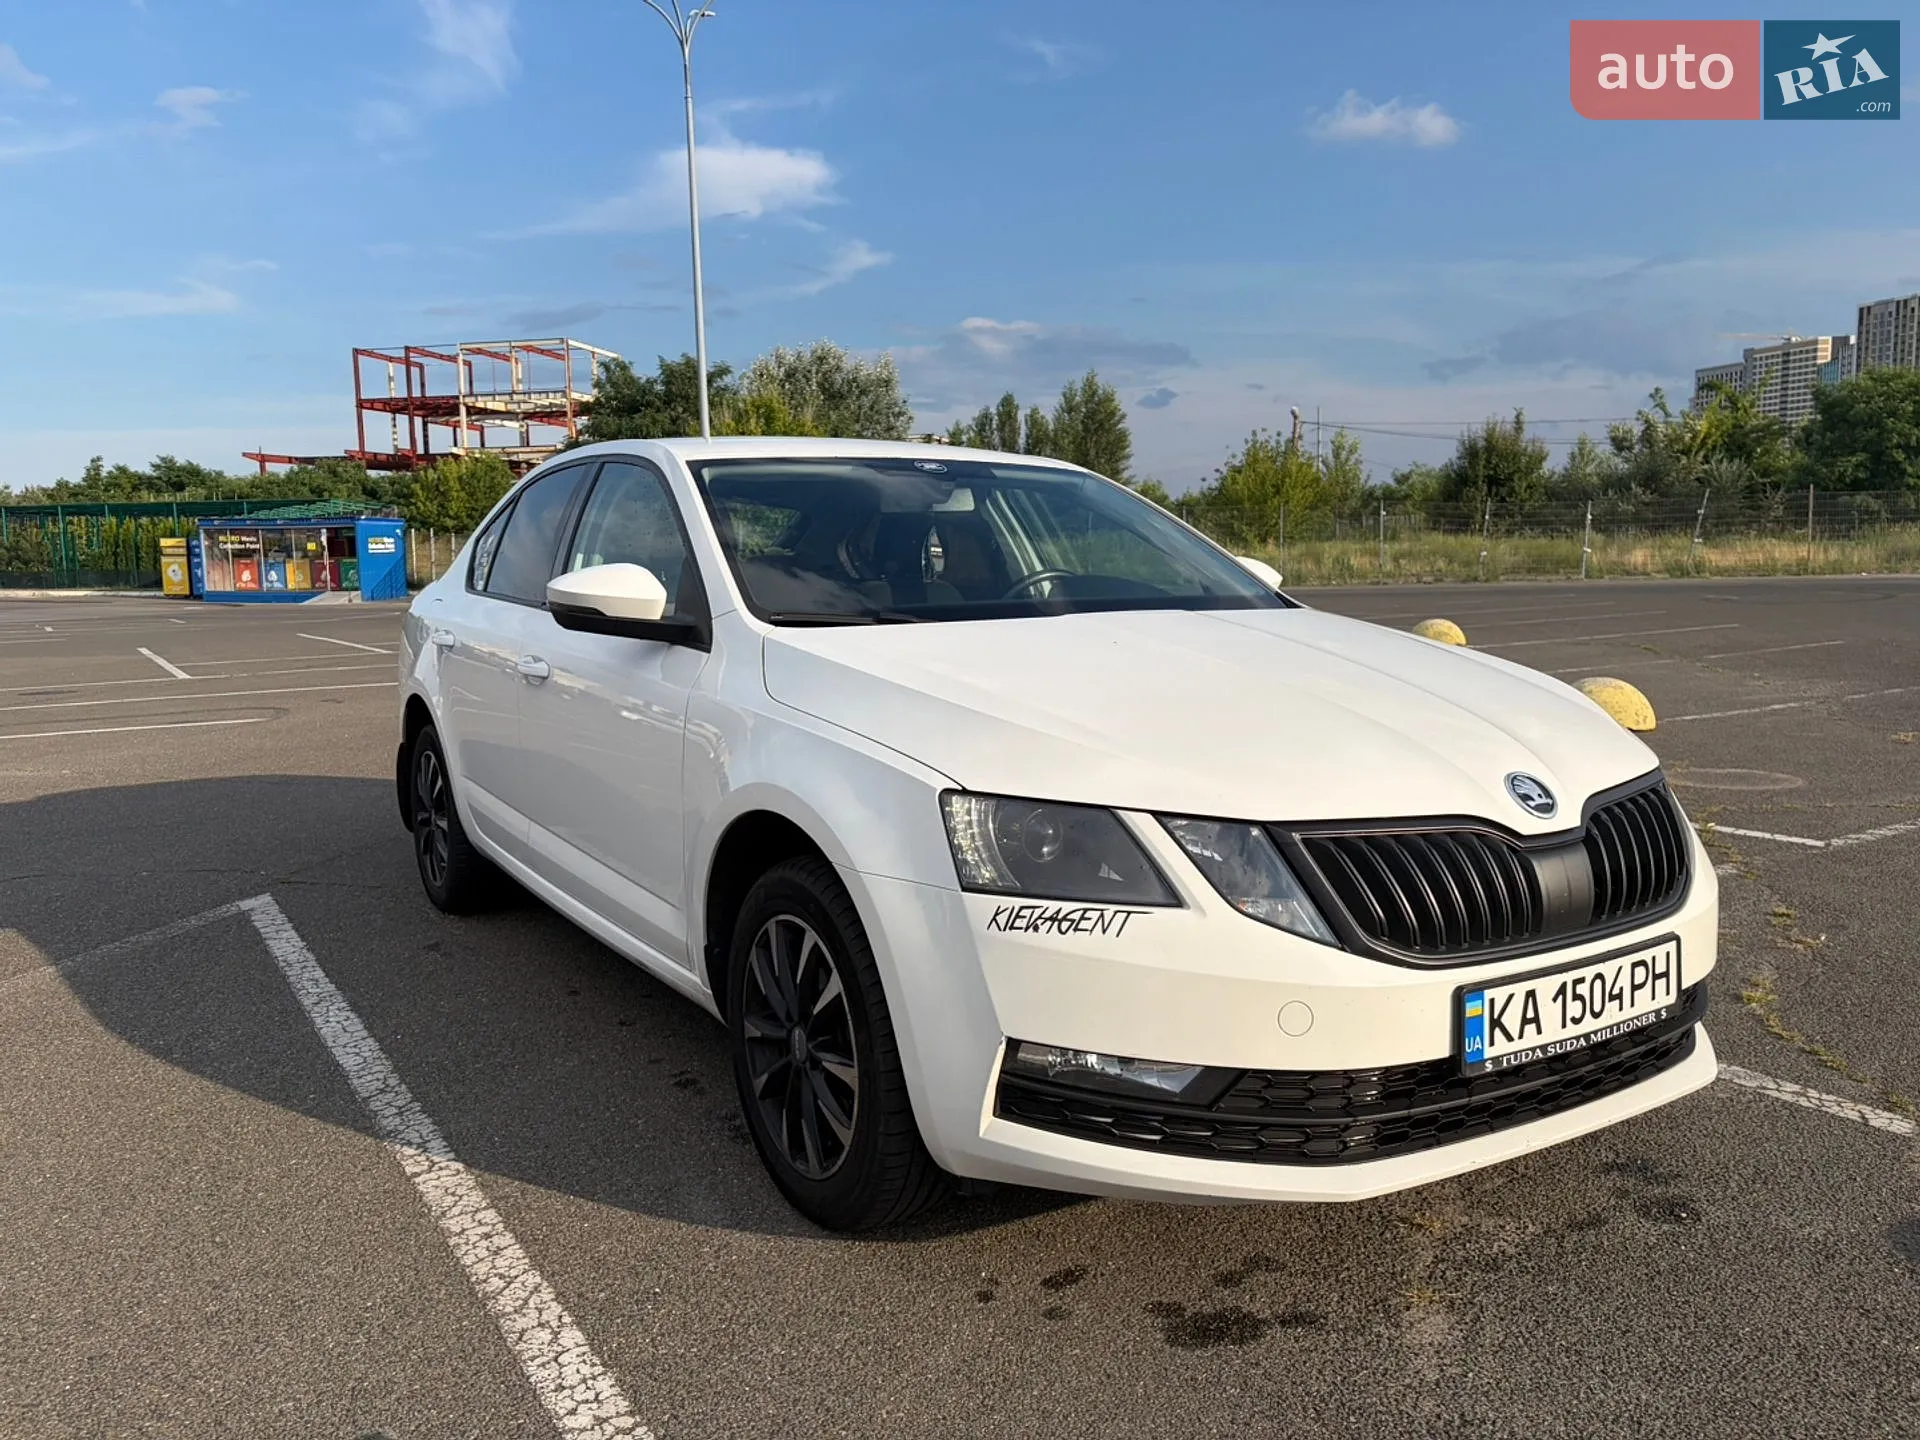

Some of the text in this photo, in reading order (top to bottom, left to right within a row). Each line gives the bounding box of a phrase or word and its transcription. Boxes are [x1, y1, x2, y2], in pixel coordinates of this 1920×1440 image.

[1488, 950, 1671, 1048] KA 1504 PH
[1465, 1035, 1483, 1053] UA
[1500, 1048, 1543, 1067] TUDA
[1546, 1036, 1587, 1056] SUDA
[1590, 1012, 1657, 1044] MILLIONER
